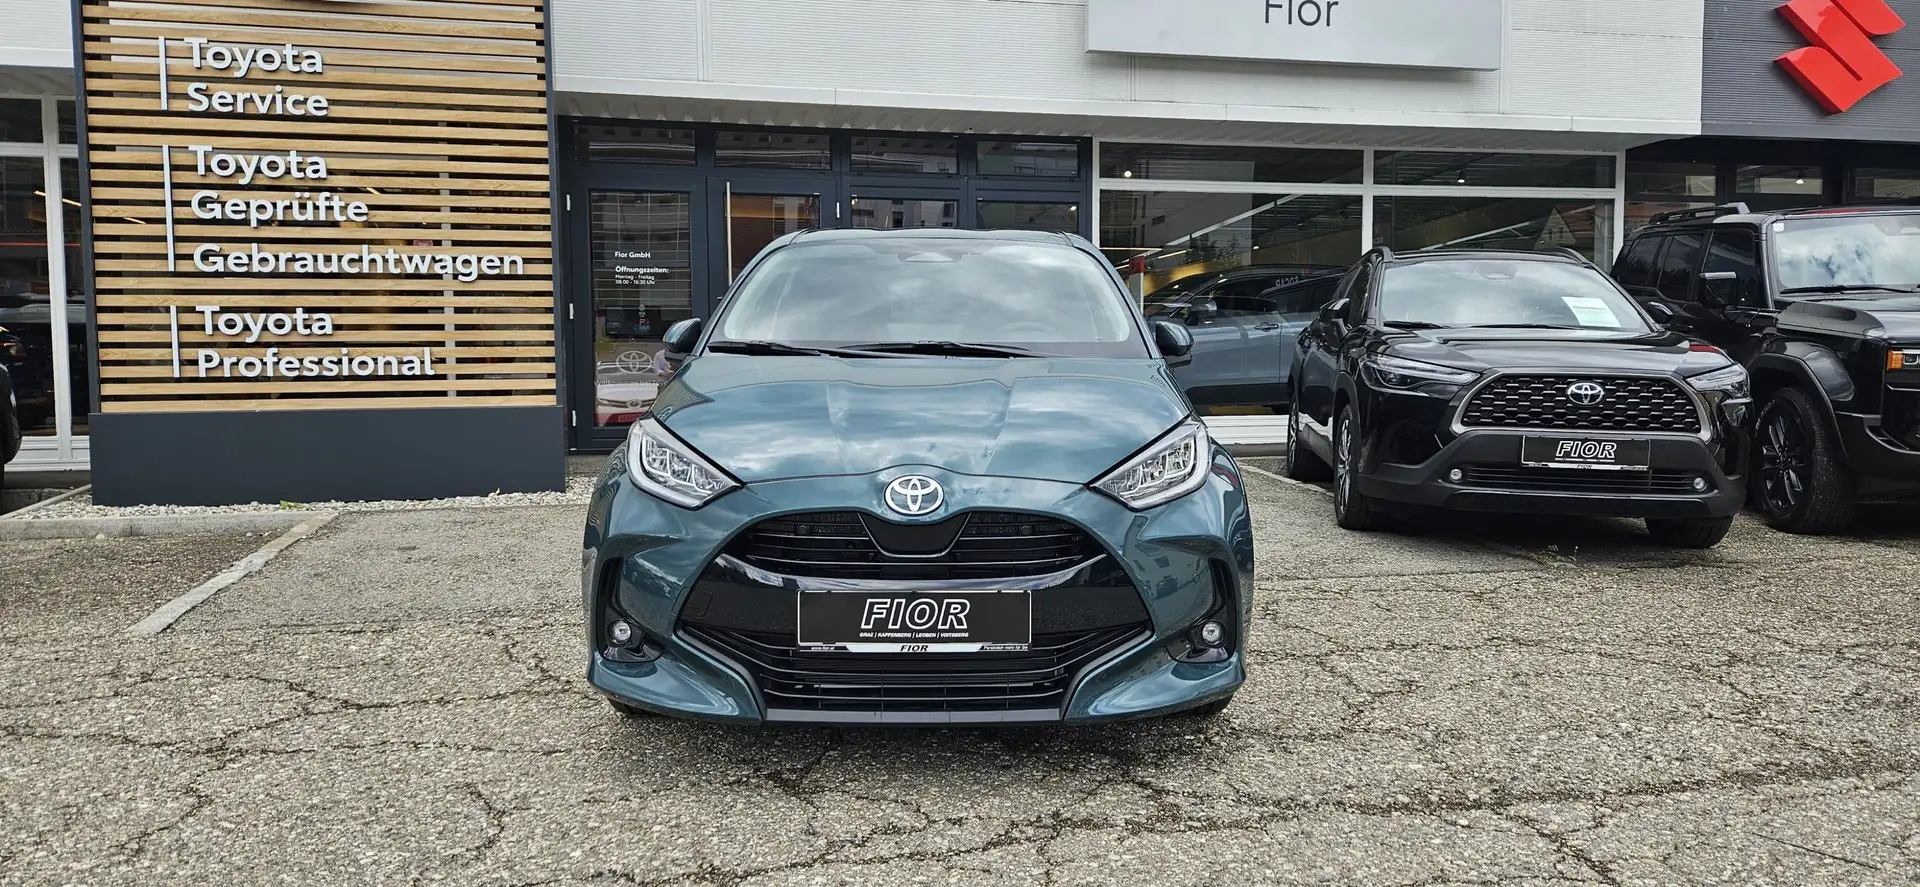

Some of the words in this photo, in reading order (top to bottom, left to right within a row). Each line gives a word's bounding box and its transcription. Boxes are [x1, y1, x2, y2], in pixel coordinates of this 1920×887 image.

[1265, 0, 1339, 27] Fior
[184, 37, 324, 77] Toyota
[187, 83, 329, 117] Service
[188, 145, 328, 185] Toyota
[191, 190, 369, 229] Geprüfte
[193, 243, 524, 283] Gebrauchtwagen
[615, 266, 668, 274] Öffnungszeiten:
[196, 305, 333, 342] Toyota
[197, 347, 435, 378] Professional
[1556, 440, 1617, 458] FIOR
[861, 598, 970, 629] FIOR
